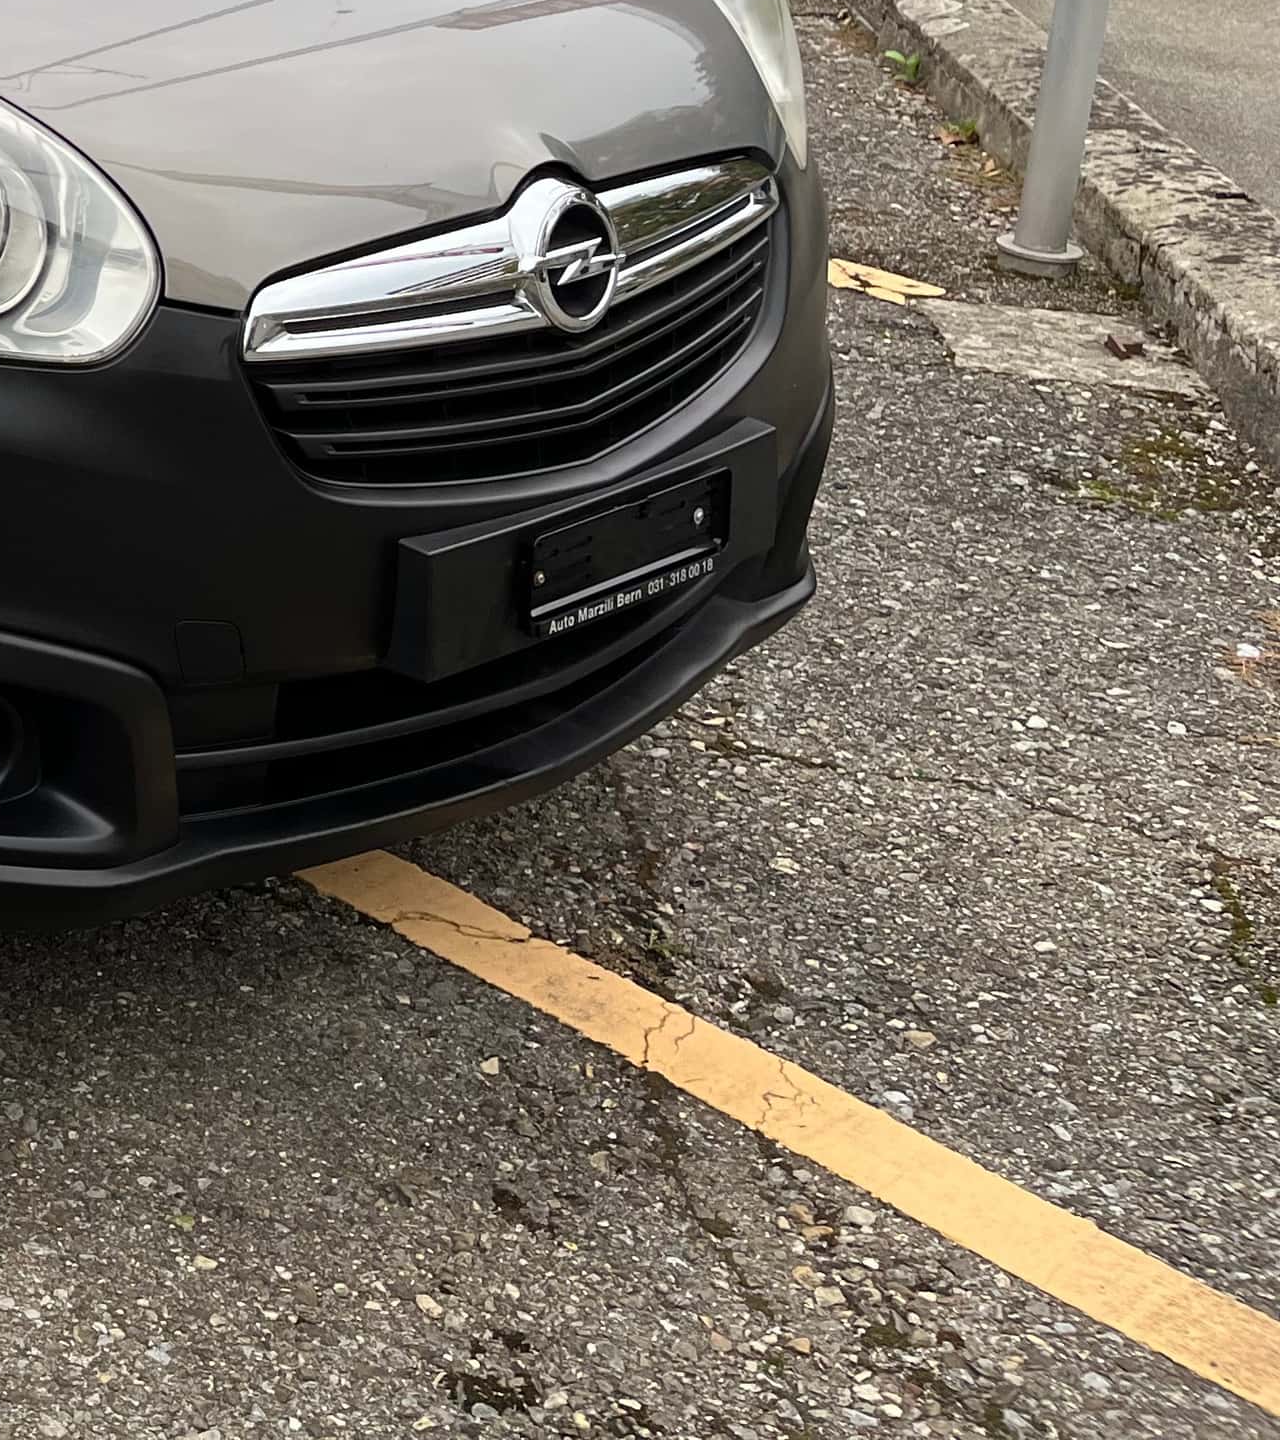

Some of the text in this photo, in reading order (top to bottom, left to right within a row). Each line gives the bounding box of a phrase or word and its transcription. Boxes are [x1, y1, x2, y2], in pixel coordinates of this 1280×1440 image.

[548, 616, 575, 635] Auto
[578, 597, 615, 623] Marzili
[616, 589, 642, 608] Bern
[688, 563, 700, 579] 00
[702, 558, 713, 573] 18
